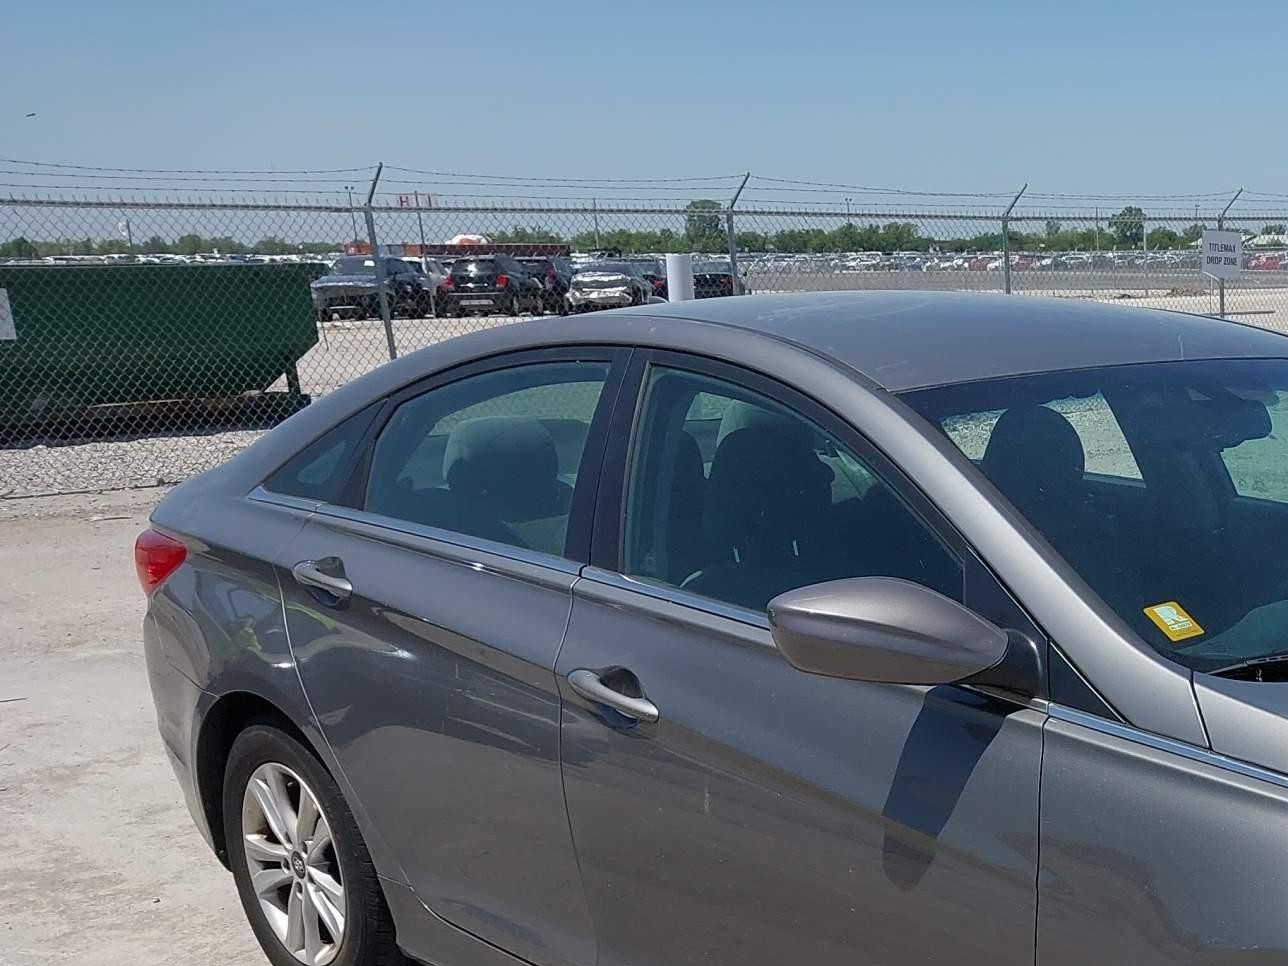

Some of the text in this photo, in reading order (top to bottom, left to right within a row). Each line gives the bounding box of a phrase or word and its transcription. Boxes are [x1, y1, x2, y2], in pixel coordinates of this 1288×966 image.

[1209, 243, 1236, 253] TITLEMAX
[1206, 256, 1238, 266] DROP ZONE
